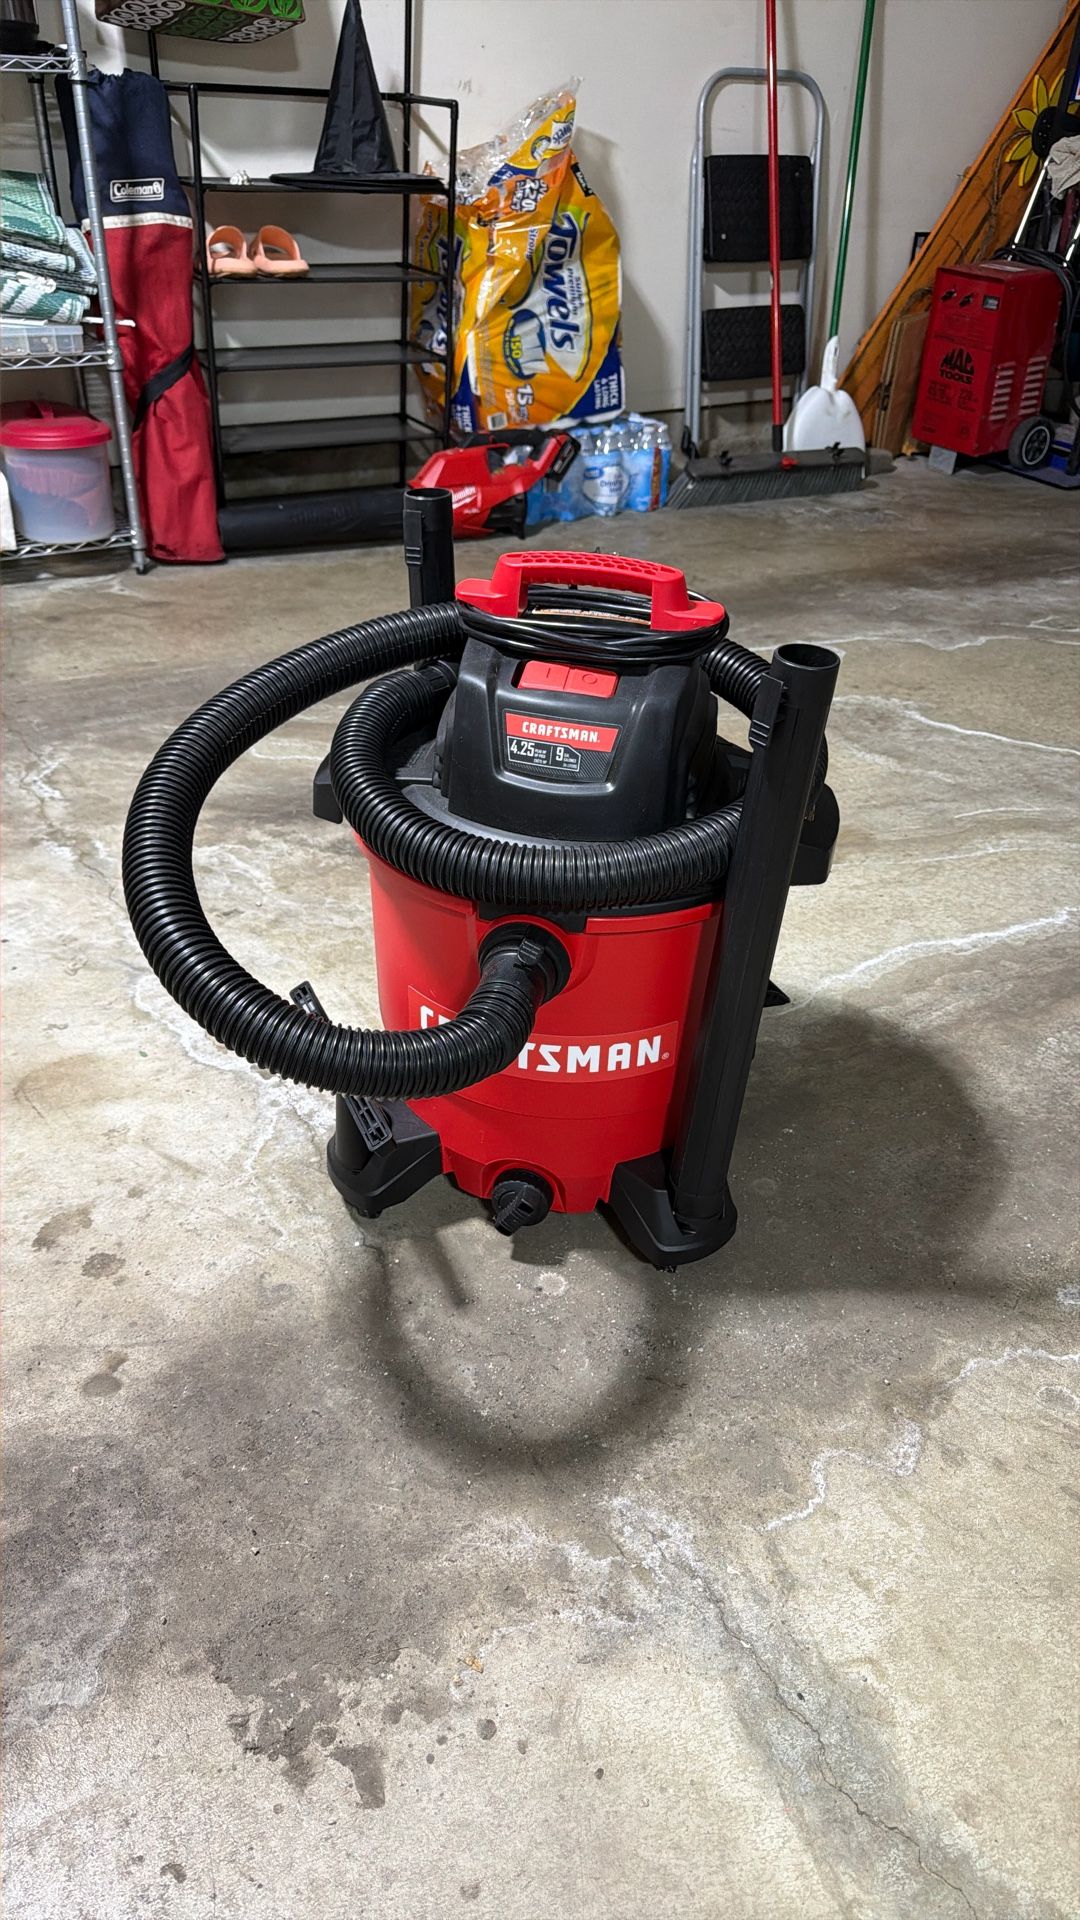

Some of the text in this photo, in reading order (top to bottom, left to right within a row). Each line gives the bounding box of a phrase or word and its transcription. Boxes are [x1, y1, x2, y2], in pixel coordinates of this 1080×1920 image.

[113, 182, 153, 196] Coleman
[543, 211, 580, 354] Towels
[511, 335, 523, 359] 150
[940, 348, 974, 375] MAC
[940, 368, 973, 385] TOOLS
[516, 384, 534, 406] 15
[608, 372, 619, 407] THICK
[522, 722, 599, 743] CRAFTSMAN
[510, 739, 535, 757] 4.25
[555, 746, 564, 762] 9
[420, 1005, 662, 1074] CTSMAN
